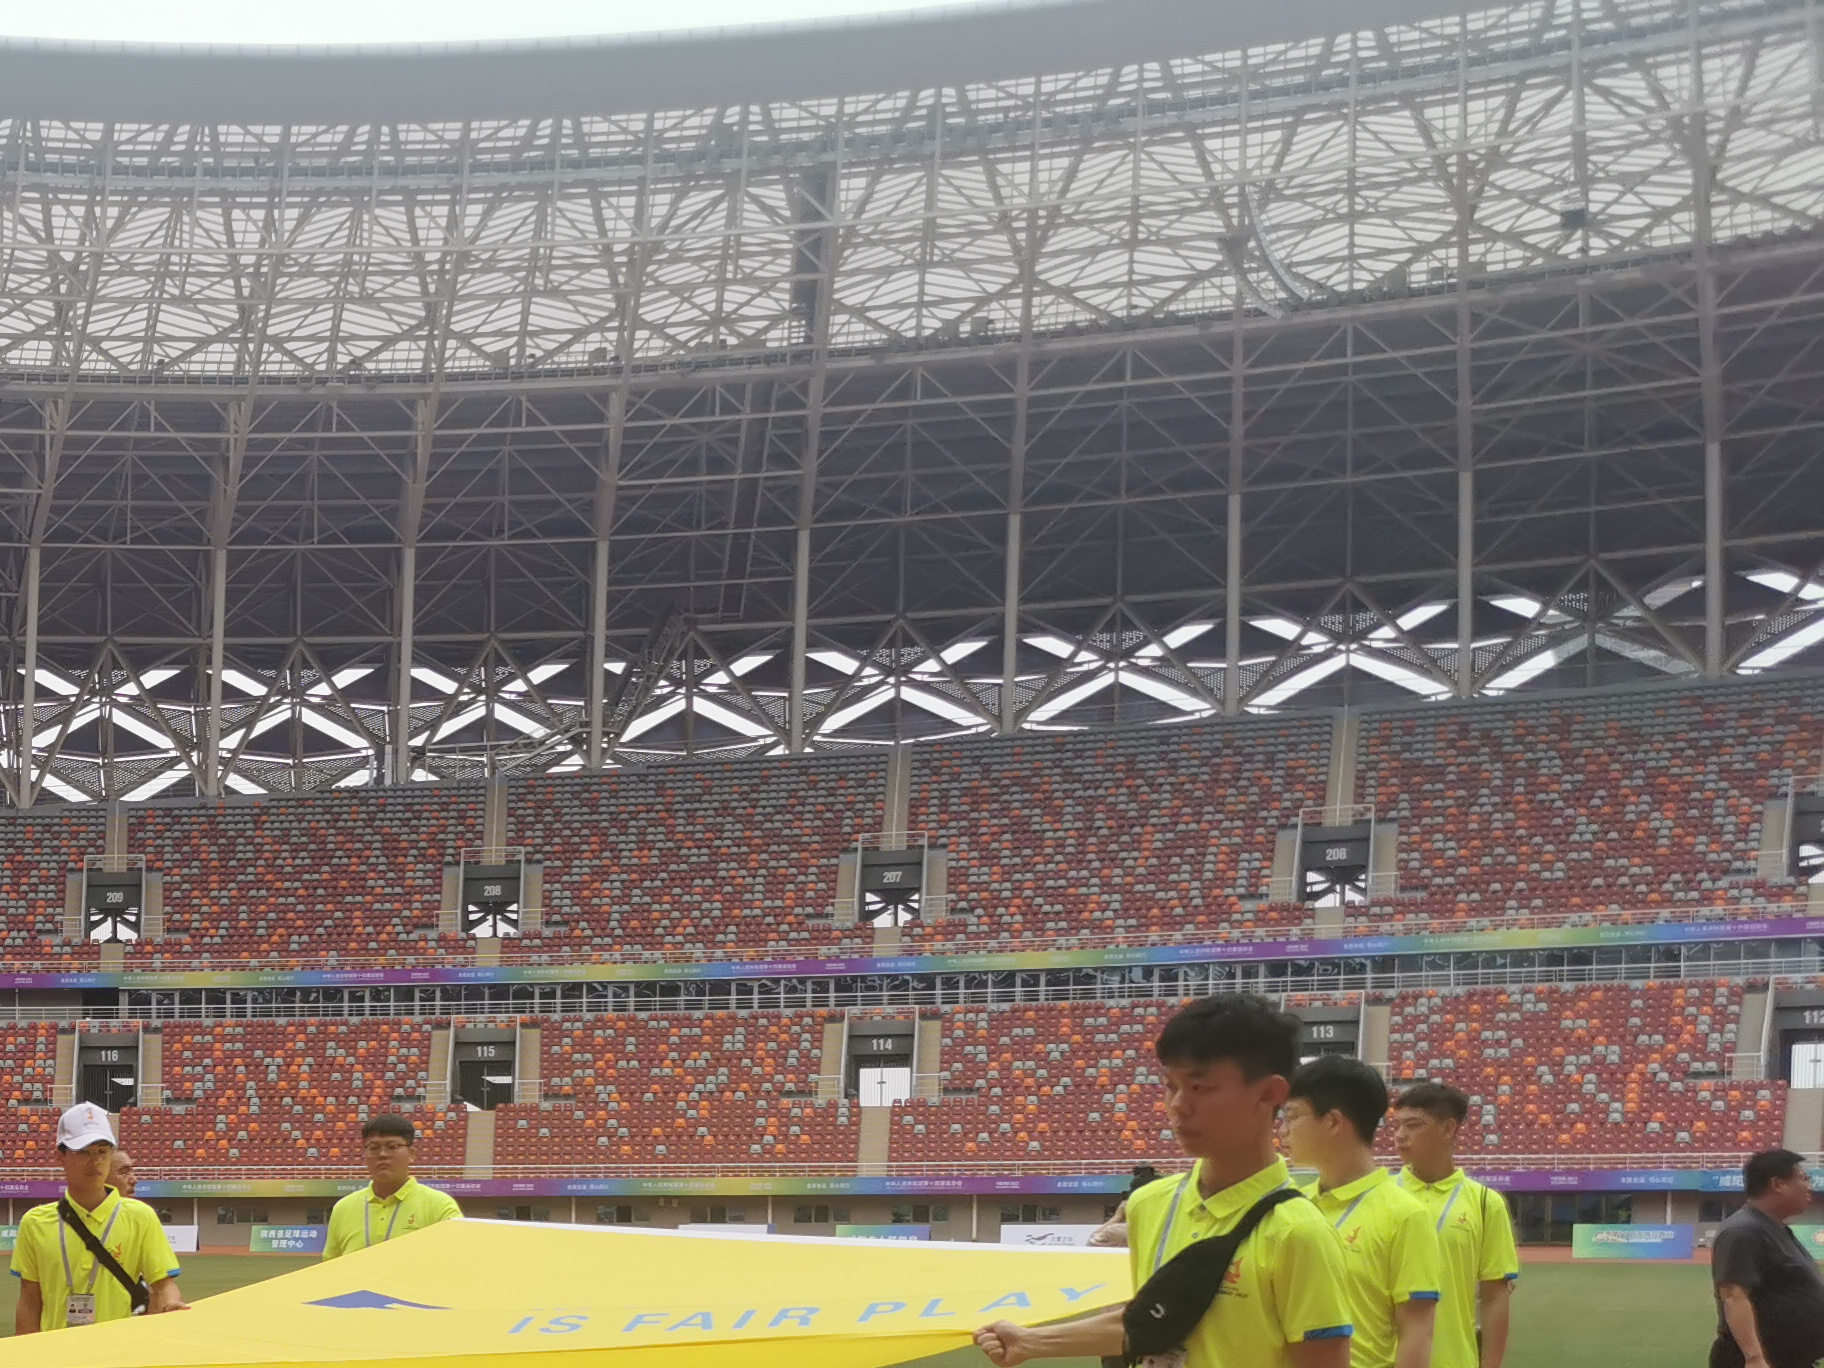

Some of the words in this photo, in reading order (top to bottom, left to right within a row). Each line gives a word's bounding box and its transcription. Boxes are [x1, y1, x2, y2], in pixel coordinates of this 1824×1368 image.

[882, 871, 902, 883] 207
[483, 885, 501, 896] 208
[106, 892, 124, 903] 209
[1311, 1026, 1334, 1039] 113
[871, 1038, 893, 1050] 114
[100, 1050, 119, 1061] 116
[475, 1046, 495, 1057] 115
[508, 1315, 591, 1334] IS
[622, 1307, 821, 1332] FAIR
[857, 1283, 1108, 1322] PLAY
